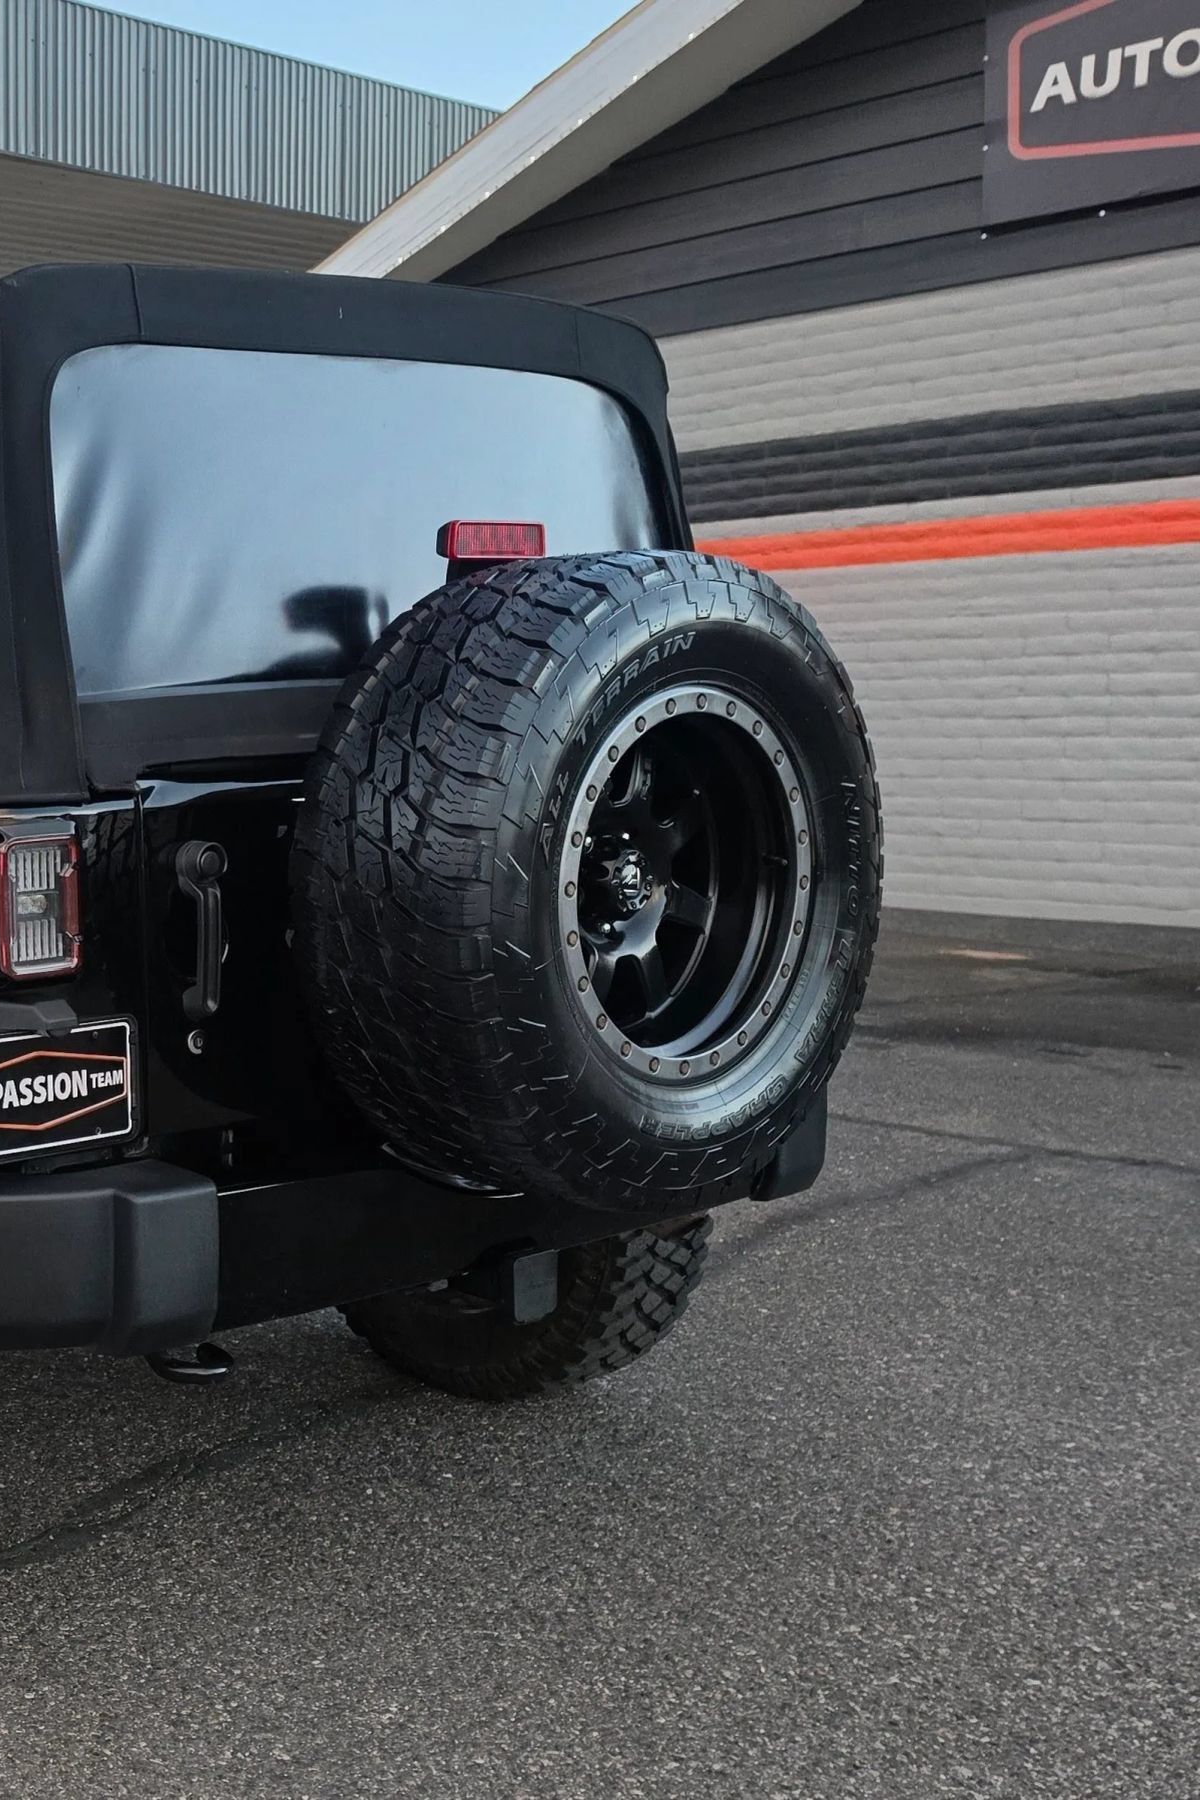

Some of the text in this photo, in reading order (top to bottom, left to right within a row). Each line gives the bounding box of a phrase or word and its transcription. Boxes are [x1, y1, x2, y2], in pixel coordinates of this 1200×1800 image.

[1029, 28, 1200, 113] AUTO
[540, 632, 695, 866] ALL TERRAIN
[90, 1069, 124, 1089] TEAM
[640, 1075, 789, 1144] GRAPPLER
